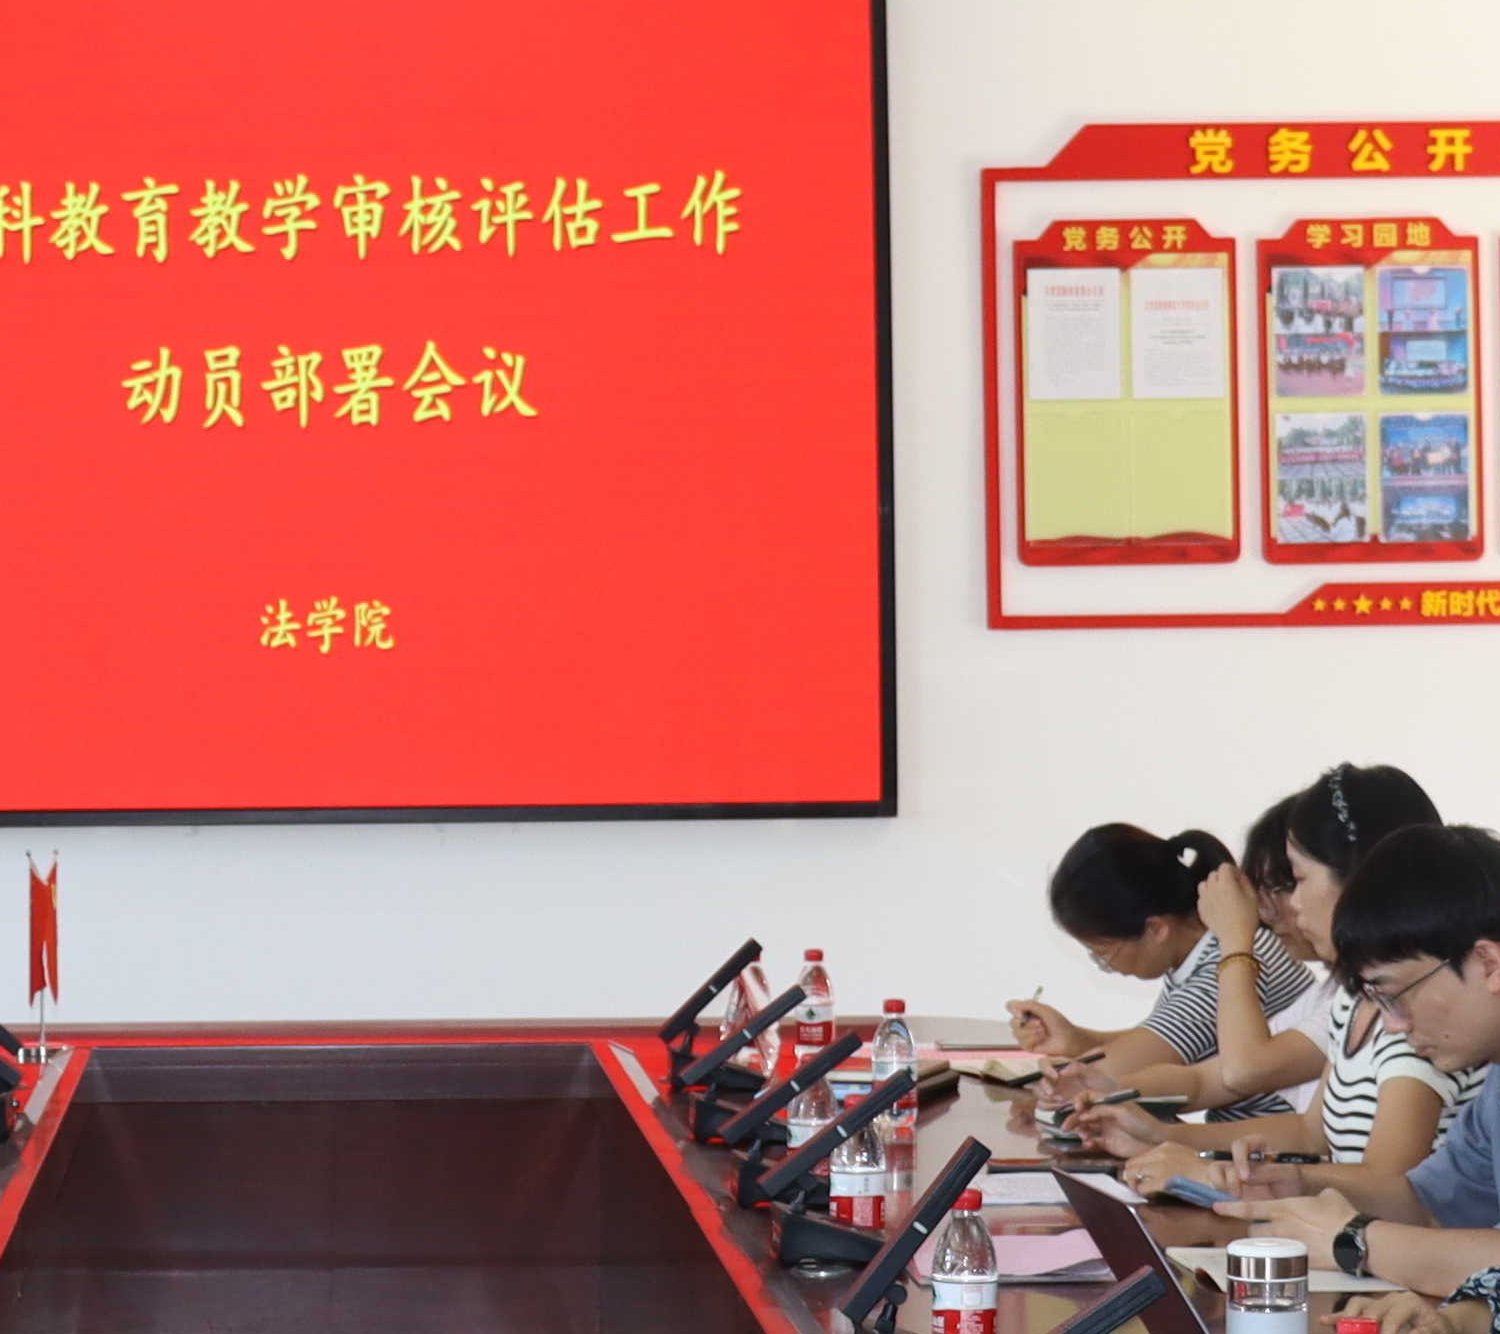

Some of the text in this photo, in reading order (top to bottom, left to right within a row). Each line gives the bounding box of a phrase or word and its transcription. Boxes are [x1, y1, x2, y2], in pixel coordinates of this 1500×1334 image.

[1062, 223, 1190, 253] 党务公开
[1306, 220, 1432, 249] 学习园地
[120, 339, 539, 429] 动员部署会议
[259, 595, 396, 655] 法学院
